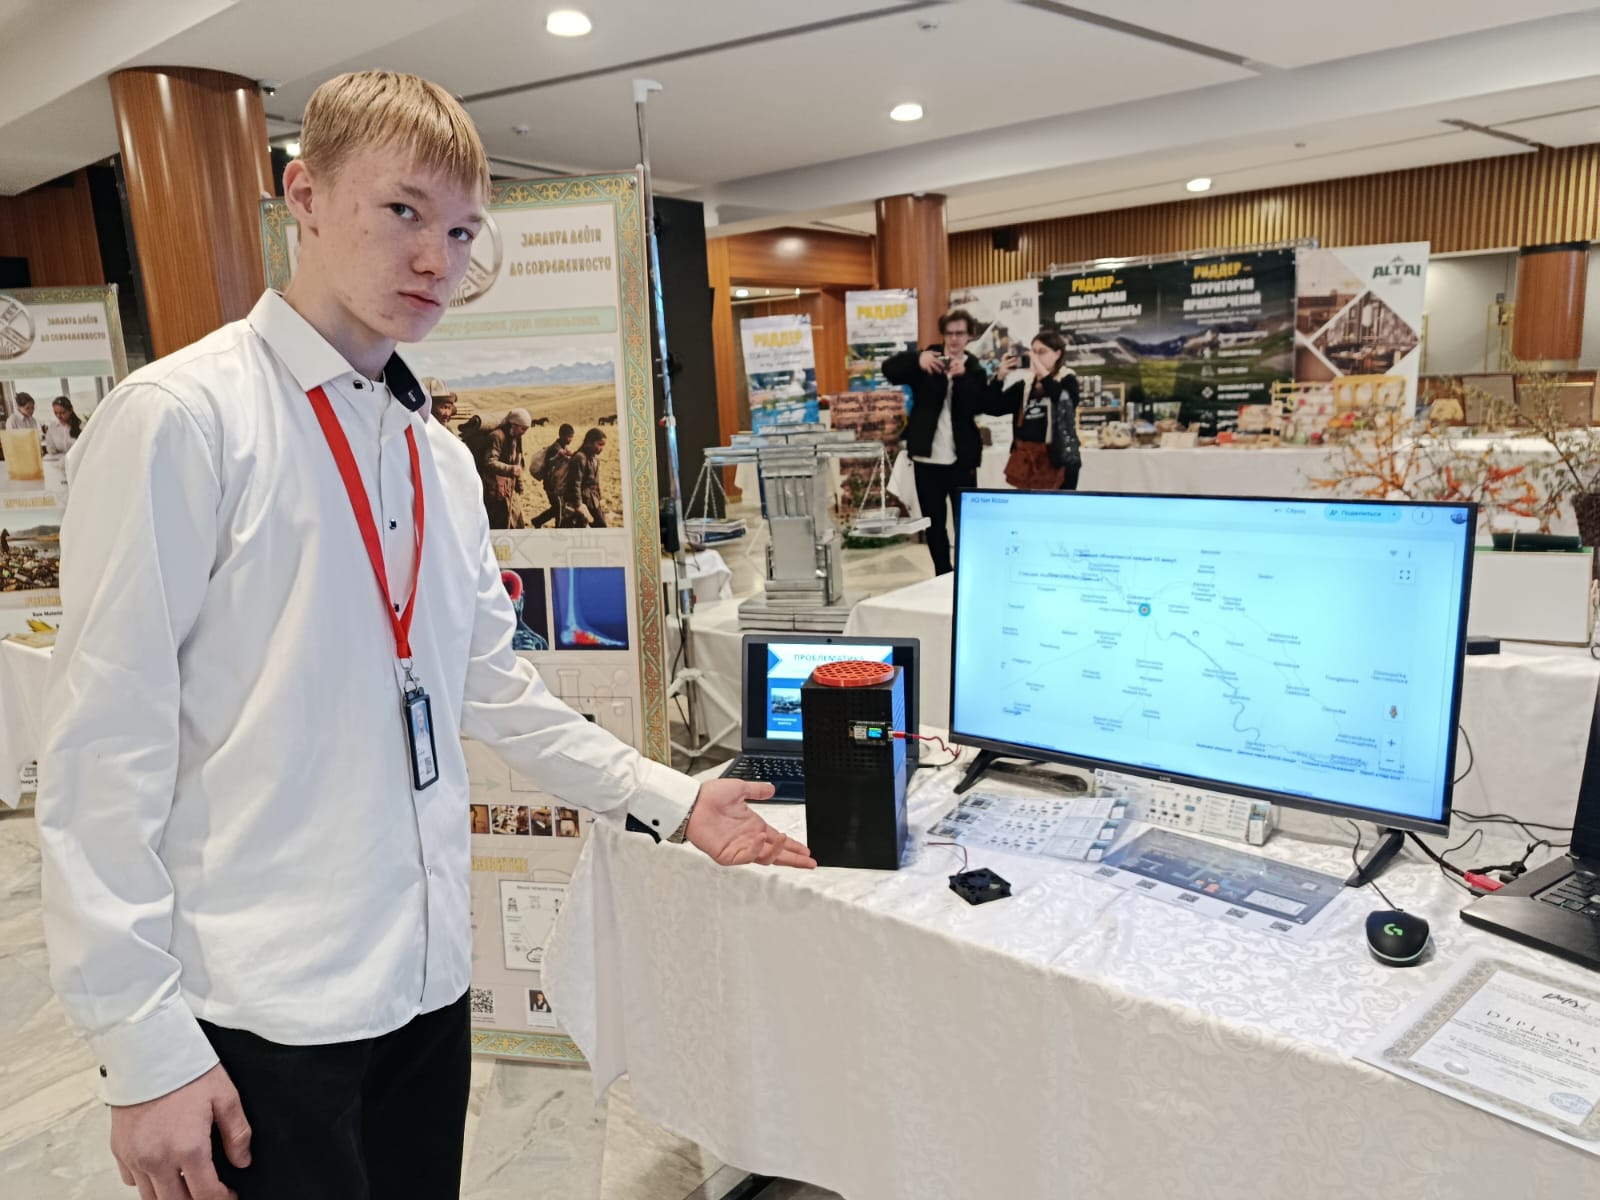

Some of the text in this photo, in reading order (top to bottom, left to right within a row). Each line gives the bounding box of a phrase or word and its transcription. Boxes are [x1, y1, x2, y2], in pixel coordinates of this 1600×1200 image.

[509, 255, 612, 277] ДО СОВРЕМЕННОСТИ
[1193, 261, 1242, 280] РИДДЕР
[1372, 263, 1421, 279] ALTAI
[1072, 275, 1114, 292] РИДДЕР
[1190, 277, 1255, 296] ТЕРРИТОРИЯ
[1000, 296, 1034, 311] ALTAI
[1183, 290, 1262, 311] ПРИКЛЮЧЕНИЙ
[856, 303, 908, 320] РИДДЕР
[752, 329, 803, 349] РИДДЕР
[1486, 1009, 1598, 1055] DIPLOMA
